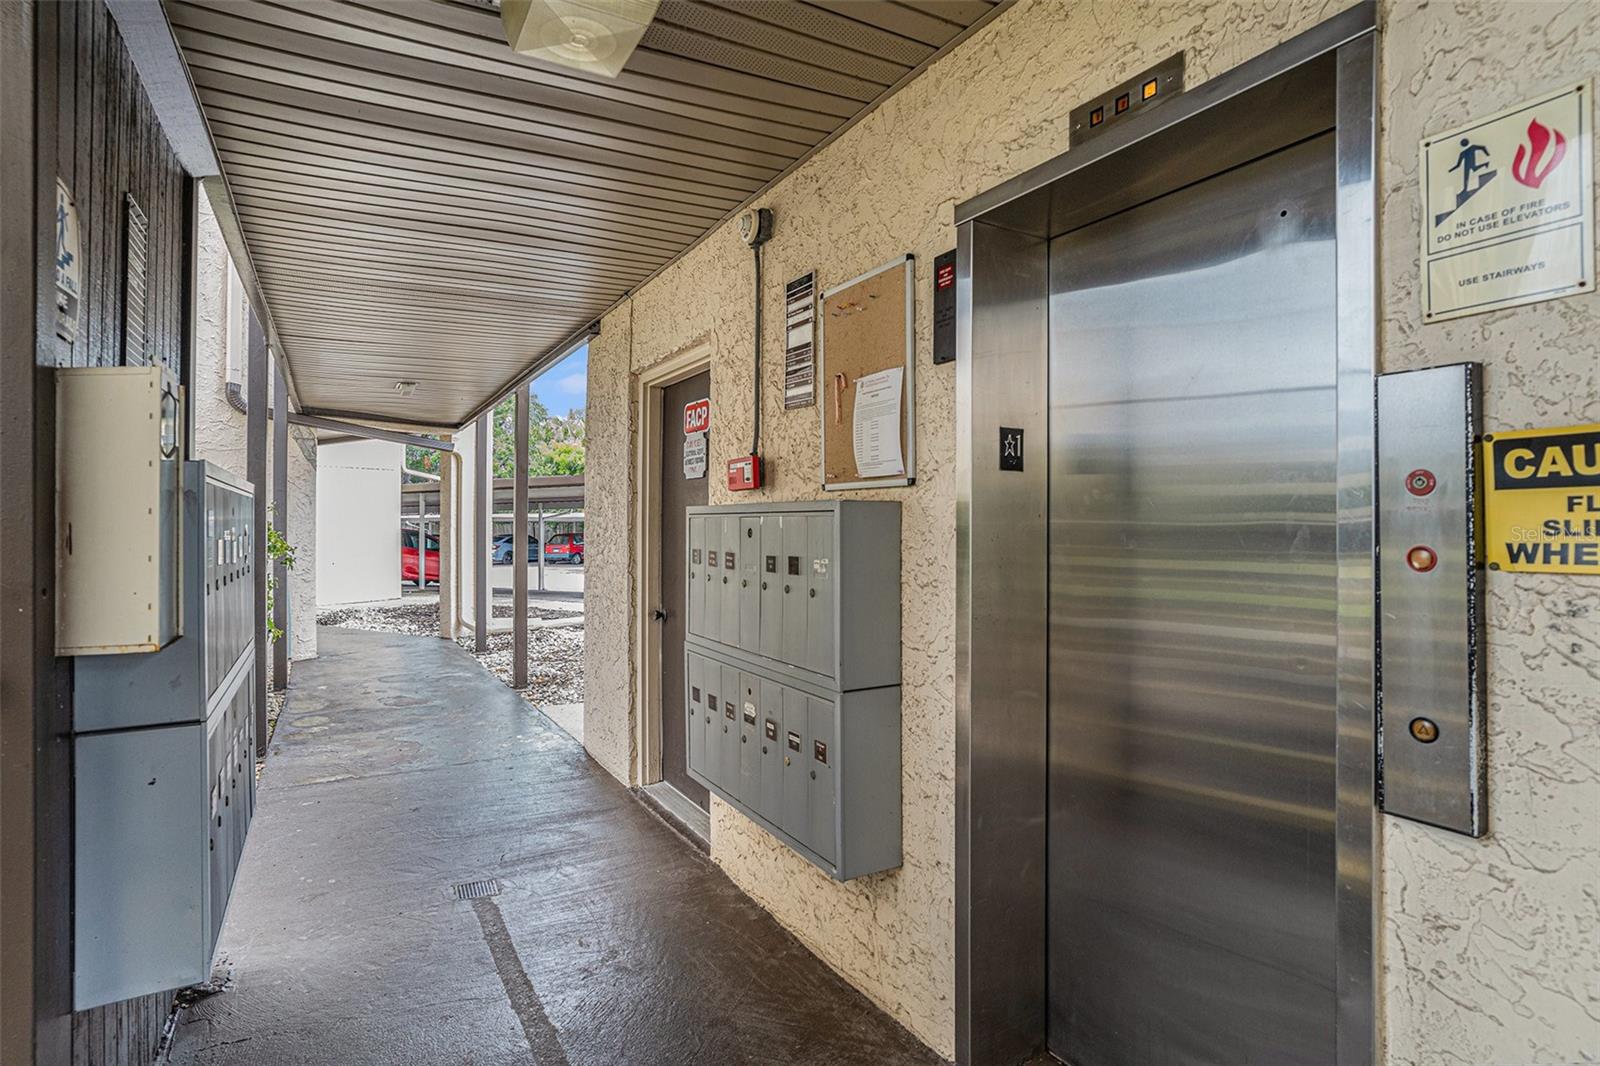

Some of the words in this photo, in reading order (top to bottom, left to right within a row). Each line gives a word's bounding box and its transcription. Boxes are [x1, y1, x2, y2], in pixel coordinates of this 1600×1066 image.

[1437, 233, 1452, 244] DO
[1454, 226, 1476, 240] NOT
[1478, 220, 1500, 234] USE
[1503, 201, 1570, 226] ELEVATORS
[1456, 220, 1468, 230] IN
[1469, 211, 1497, 226] CASE
[1501, 206, 1517, 217] OF
[1520, 198, 1545, 213] FIRE
[1458, 274, 1480, 287] USE
[1482, 261, 1545, 282] STAIRWAYS
[686, 406, 707, 429] FACP
[1504, 445, 1600, 479] CAU
[1543, 519, 1600, 537] SLI
[1506, 543, 1599, 565] WHE
